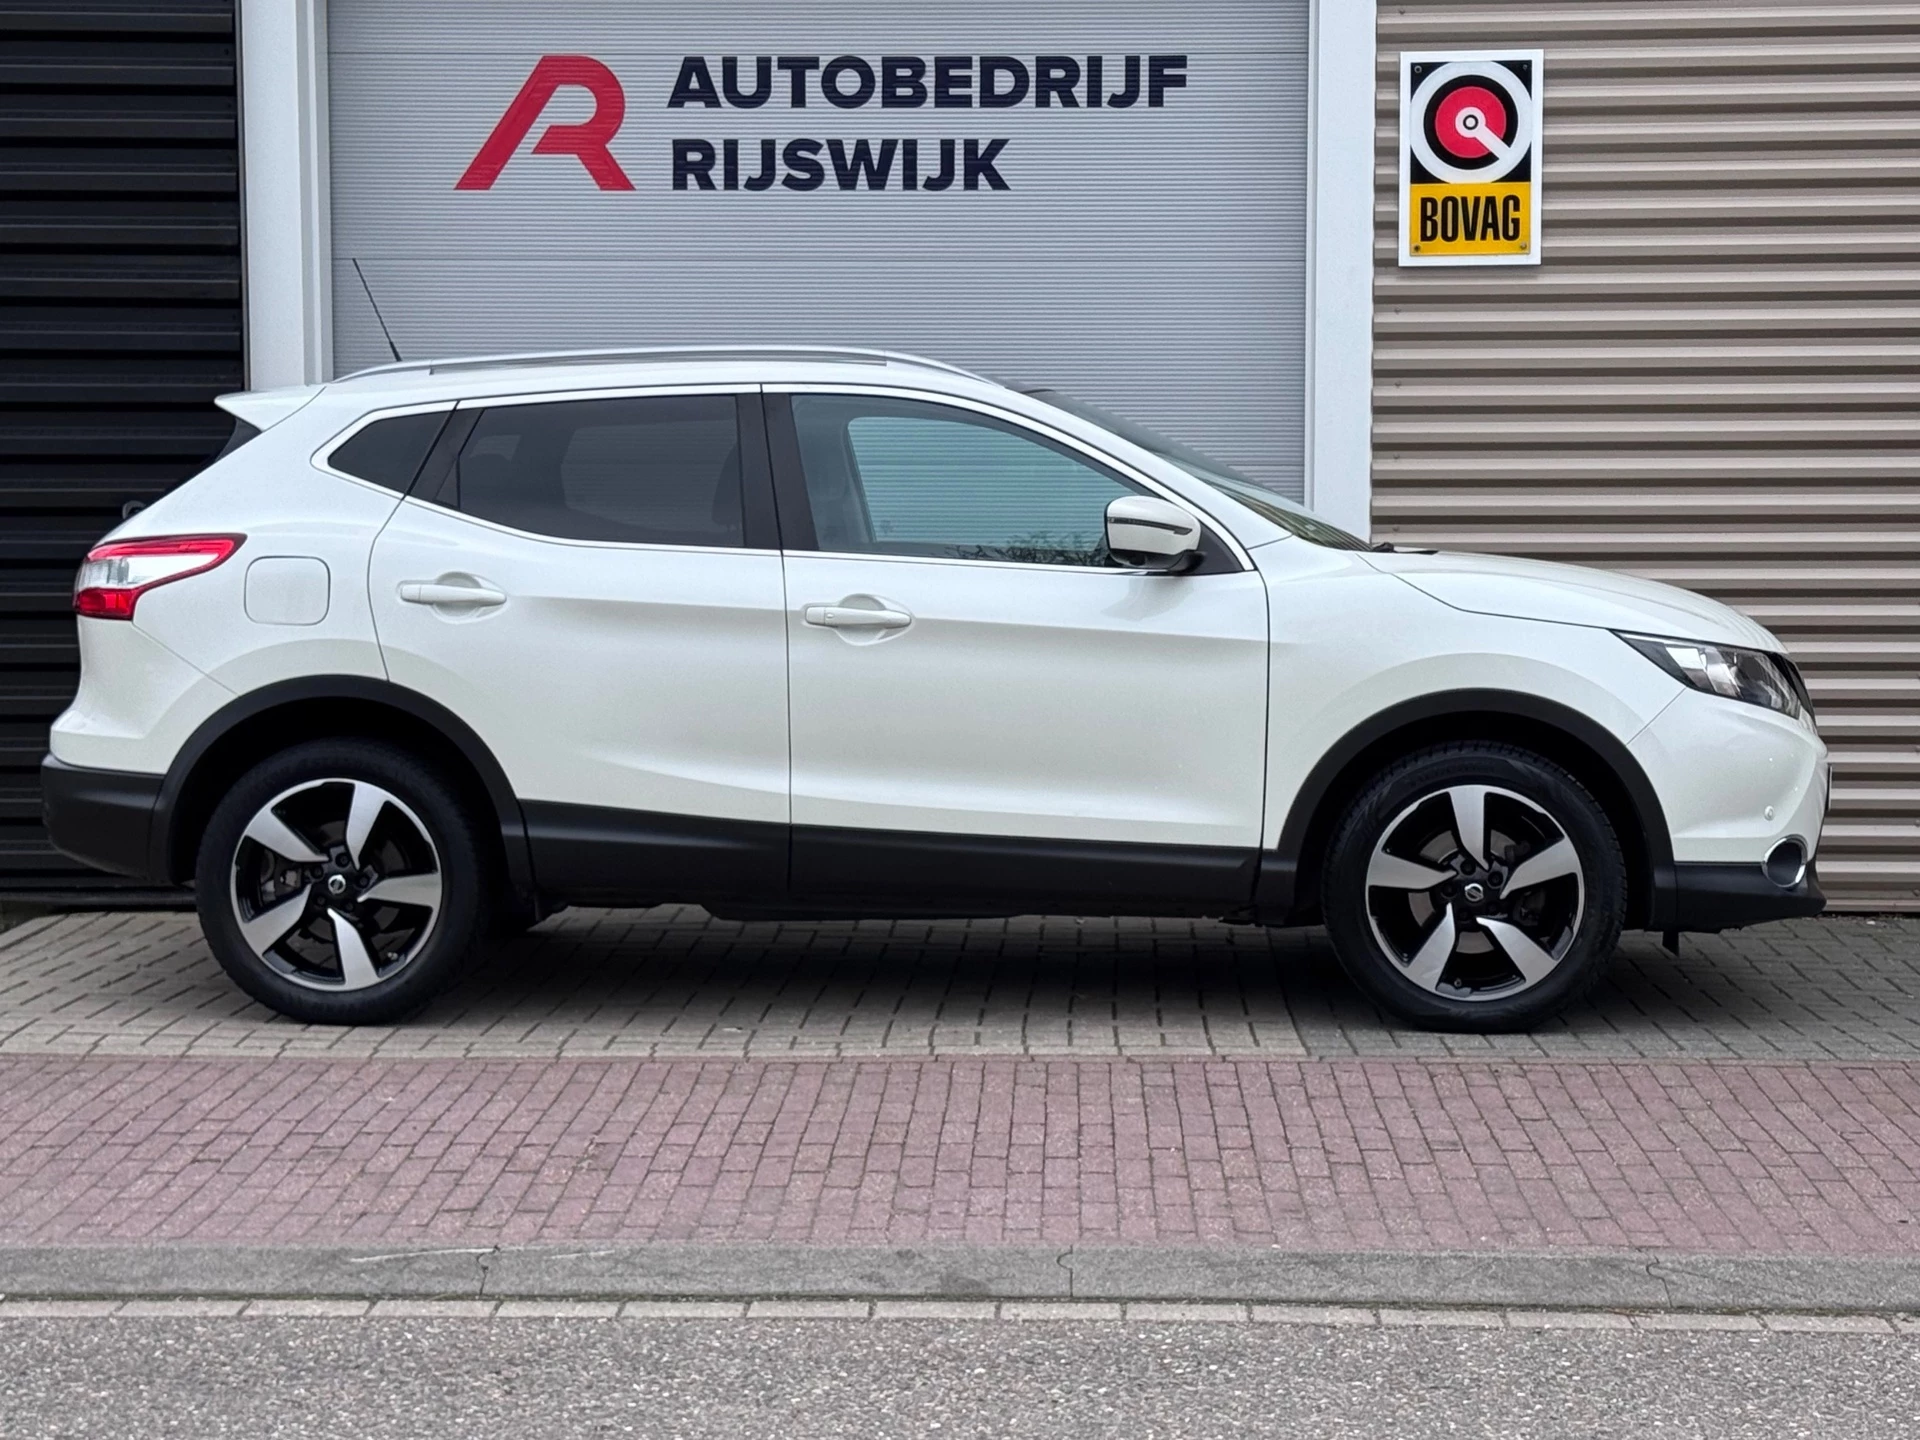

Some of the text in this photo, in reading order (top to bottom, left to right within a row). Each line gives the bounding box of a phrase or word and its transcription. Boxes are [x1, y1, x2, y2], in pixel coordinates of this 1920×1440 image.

[666, 55, 1188, 109] AUTOBEDRIJF
[672, 138, 1011, 192] RIJSWIJK
[1420, 194, 1521, 242] BOVAG
